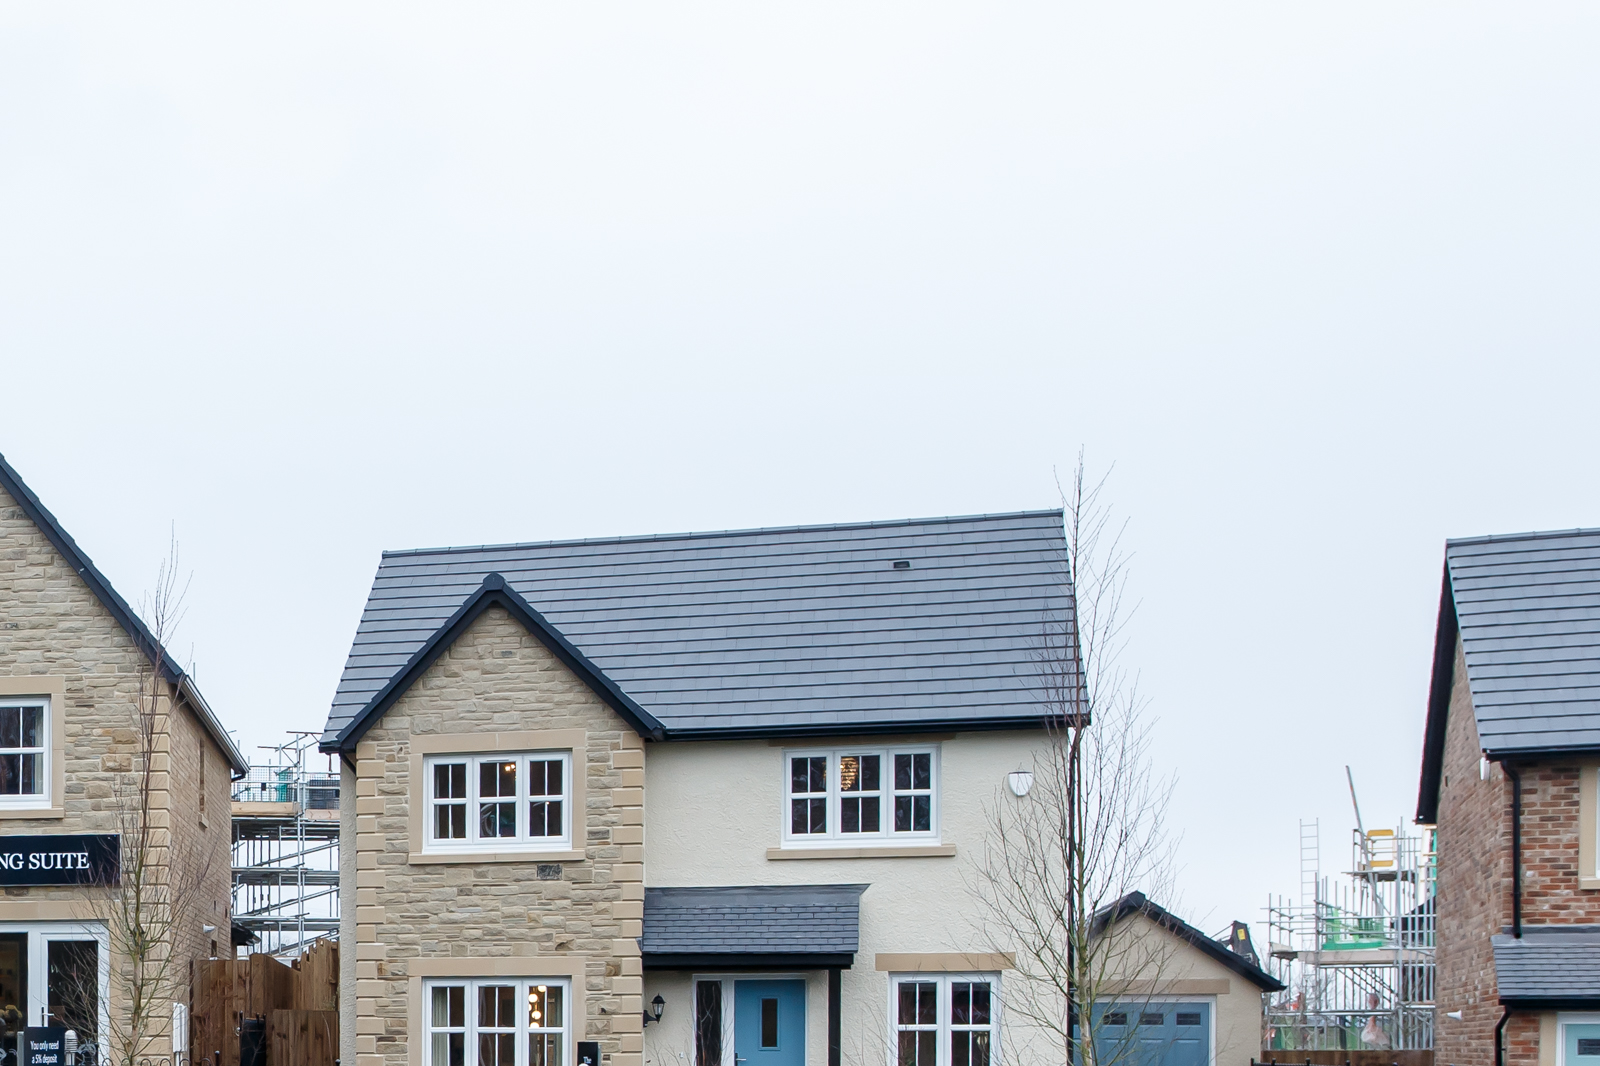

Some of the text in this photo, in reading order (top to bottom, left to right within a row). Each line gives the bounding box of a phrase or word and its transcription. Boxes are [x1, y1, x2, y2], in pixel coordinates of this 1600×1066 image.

[28, 852, 89, 869] SUITE
[30, 1041, 59, 1051] You only need
[31, 1054, 57, 1065] a 5% deposit
